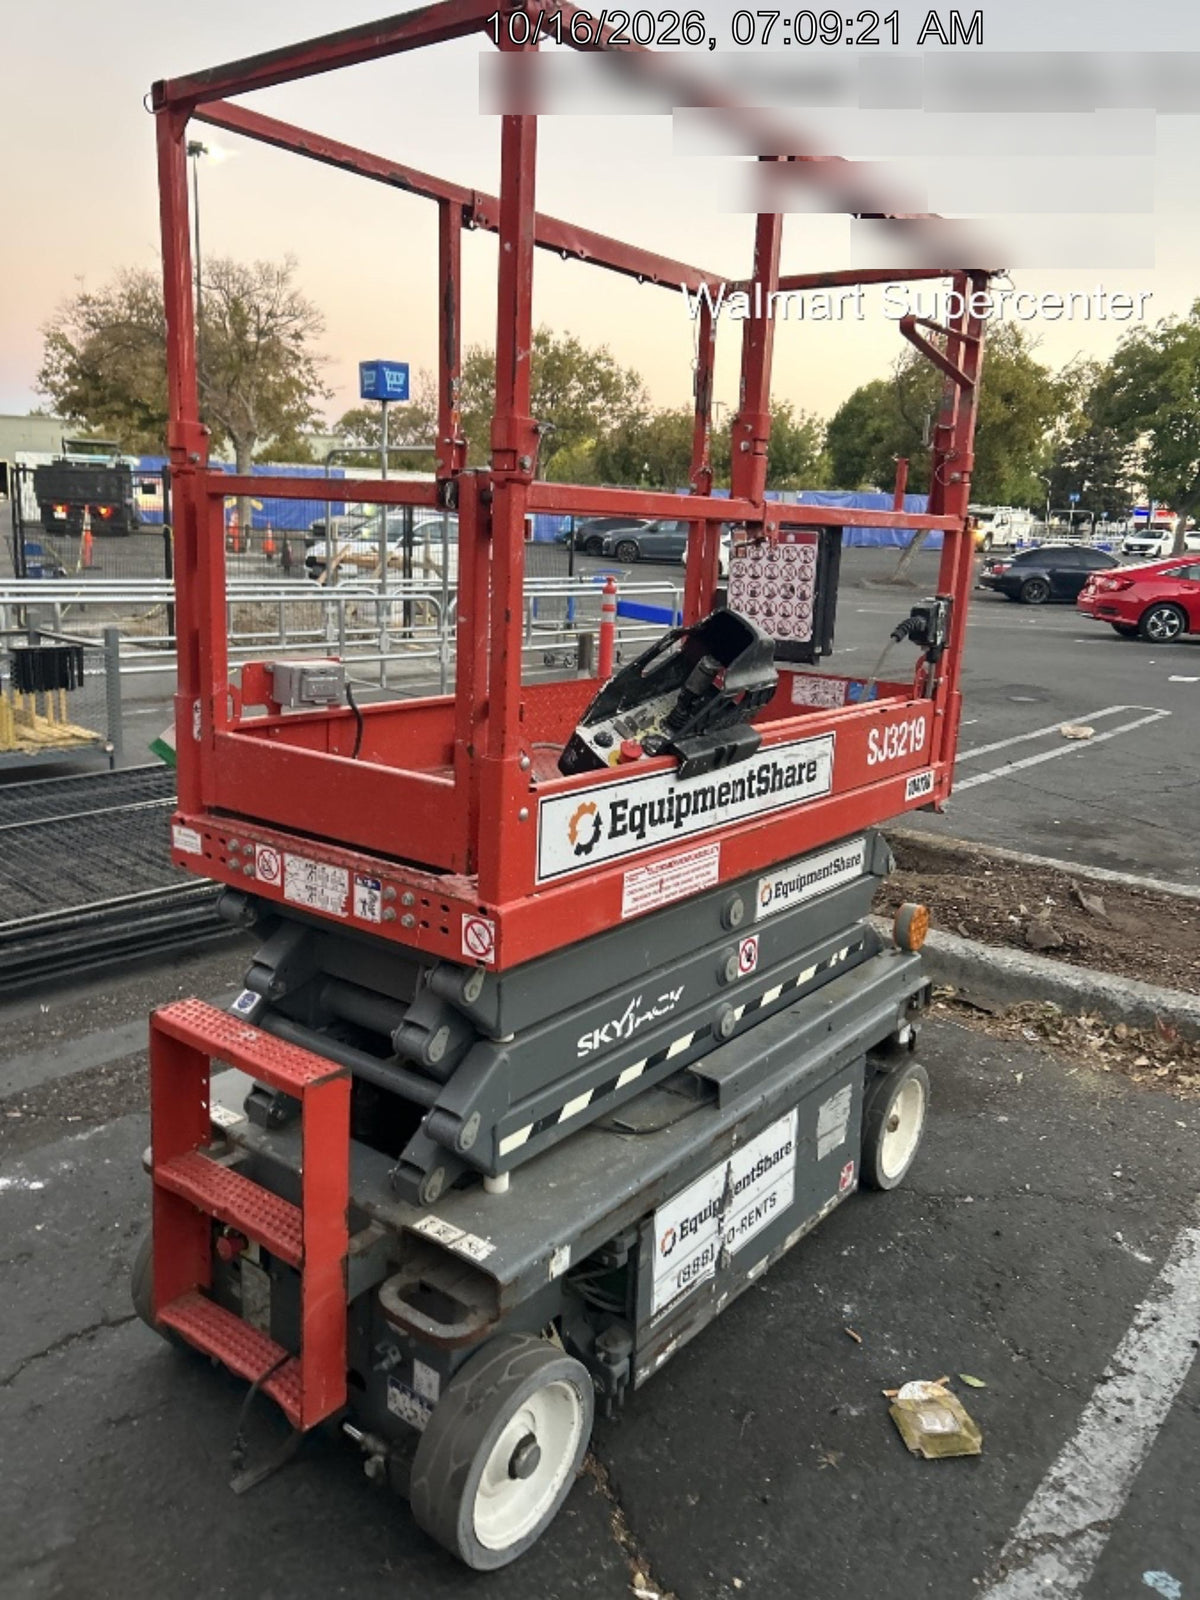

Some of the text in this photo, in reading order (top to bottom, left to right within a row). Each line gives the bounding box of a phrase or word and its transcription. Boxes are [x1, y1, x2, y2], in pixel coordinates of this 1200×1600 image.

[866, 717, 926, 766] SJ3219
[608, 760, 818, 841] EquipmentShare
[774, 853, 862, 898] EquipmentShare
[577, 986, 685, 1058] SKYJACK
[680, 1141, 792, 1241] EquipentShare
